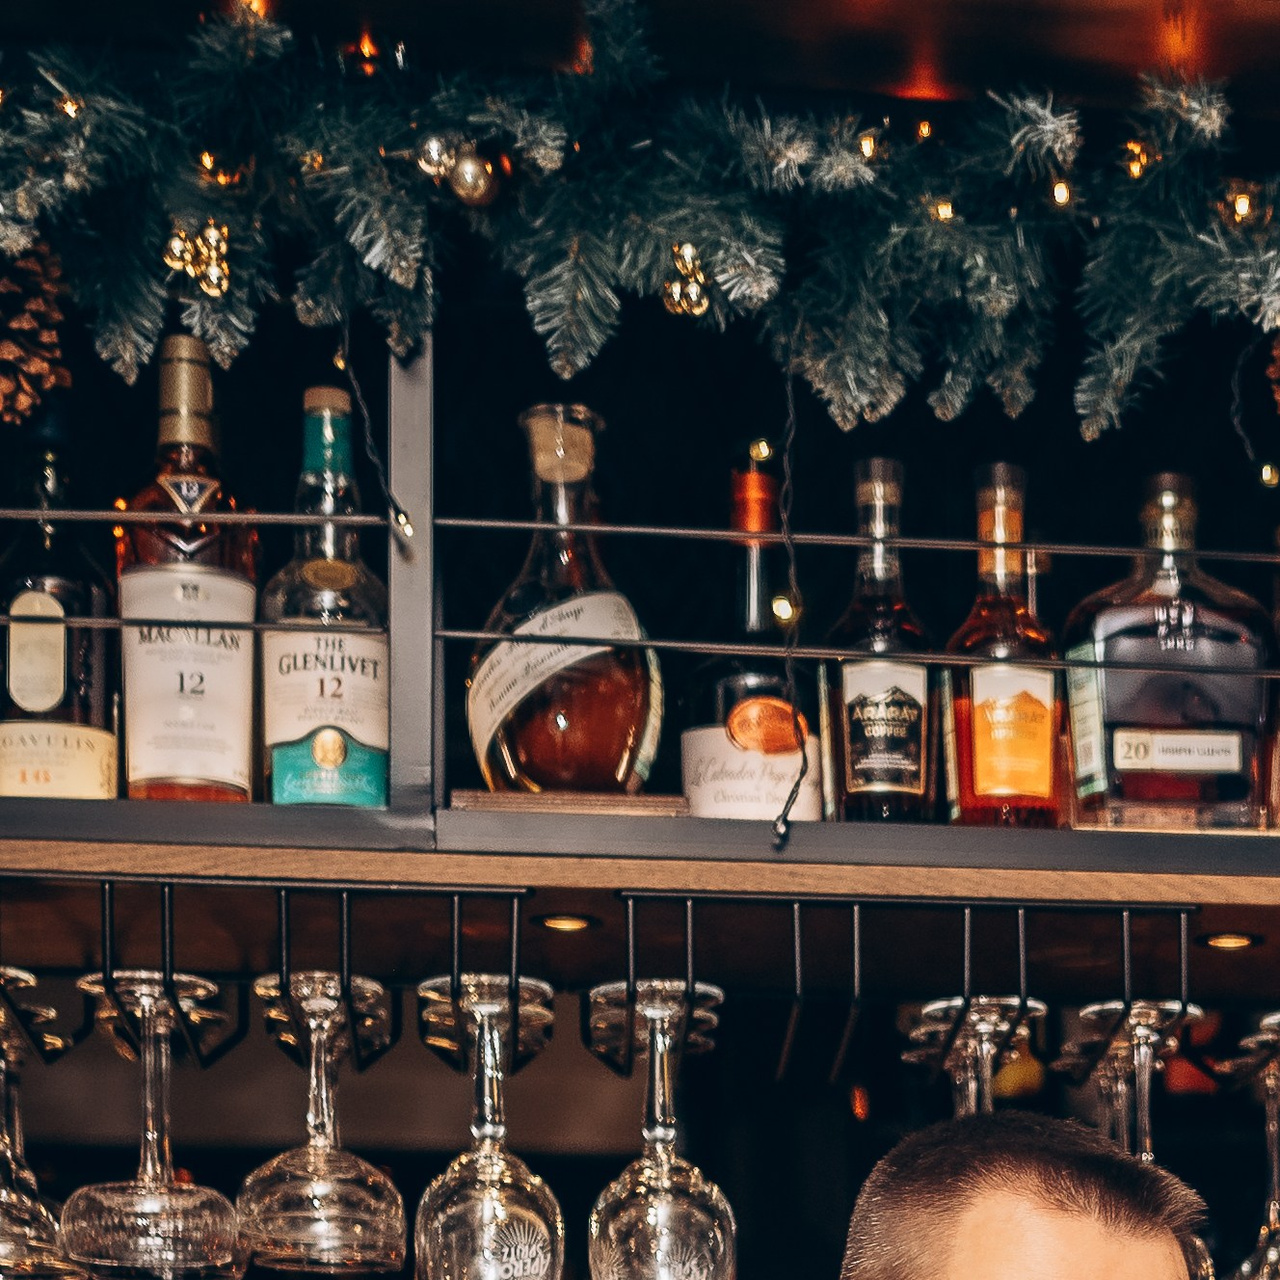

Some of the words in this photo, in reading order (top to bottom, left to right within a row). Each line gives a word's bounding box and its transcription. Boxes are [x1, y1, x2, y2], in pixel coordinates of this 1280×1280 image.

[315, 636, 347, 652] THE
[278, 653, 383, 681] GLENLIVET
[178, 671, 206, 696] 12
[317, 676, 344, 699] 12
[1122, 741, 1150, 761] 20
[501, 1243, 545, 1263] SPRITZ
[497, 1252, 551, 1280] APERO
